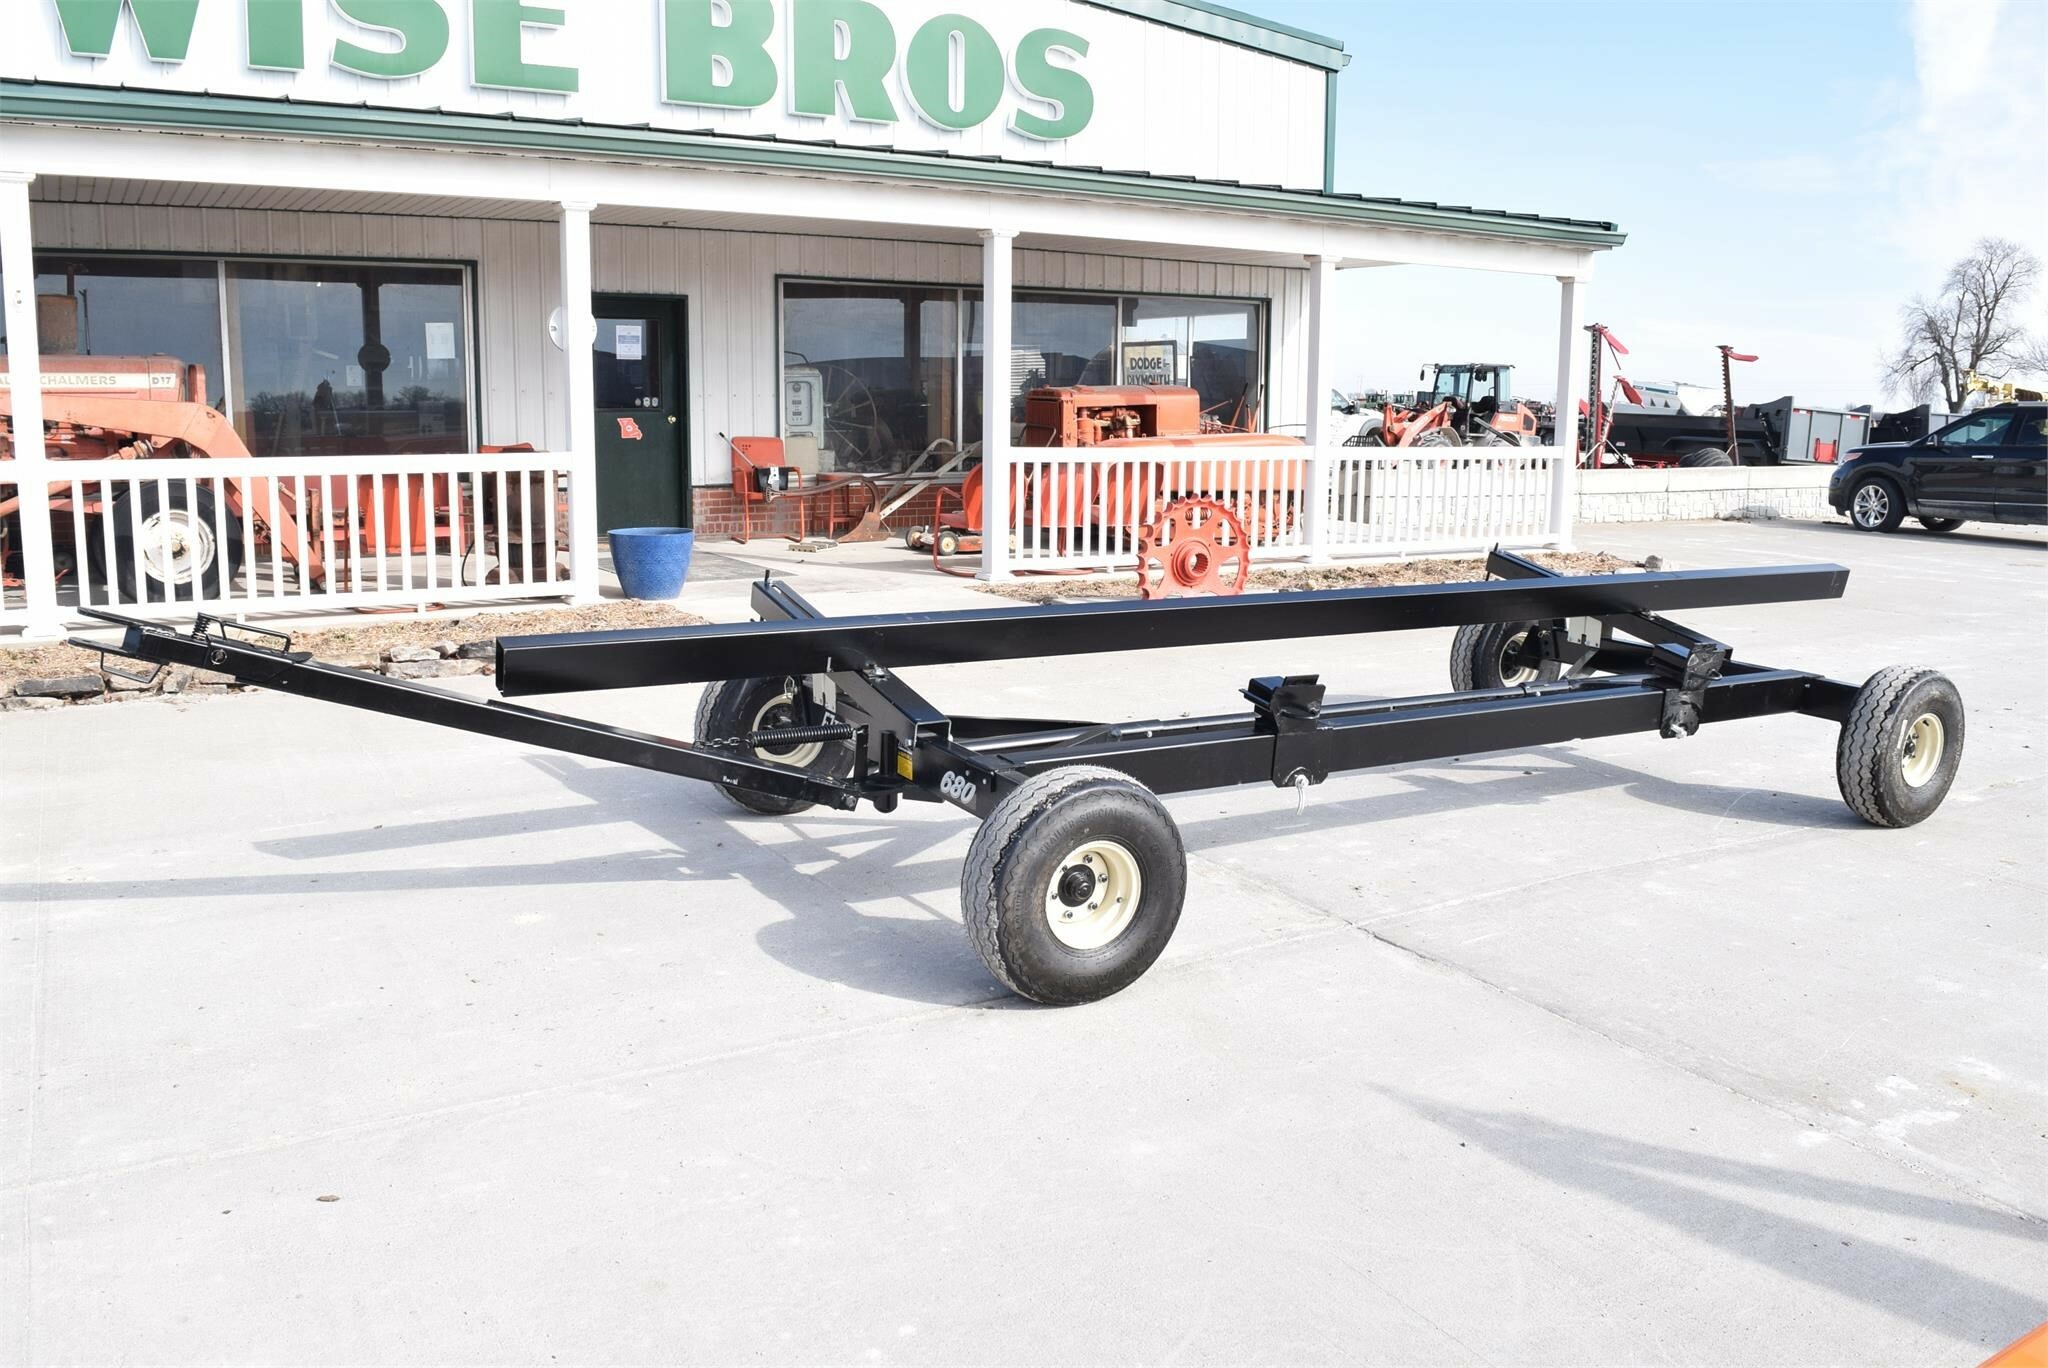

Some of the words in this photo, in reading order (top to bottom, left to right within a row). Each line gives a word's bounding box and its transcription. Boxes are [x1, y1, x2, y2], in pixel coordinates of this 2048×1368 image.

[659, 0, 1095, 142] BROS
[1130, 357, 1162, 370] DODGE
[40, 375, 117, 386] CHALMERS
[940, 770, 976, 805] 680
